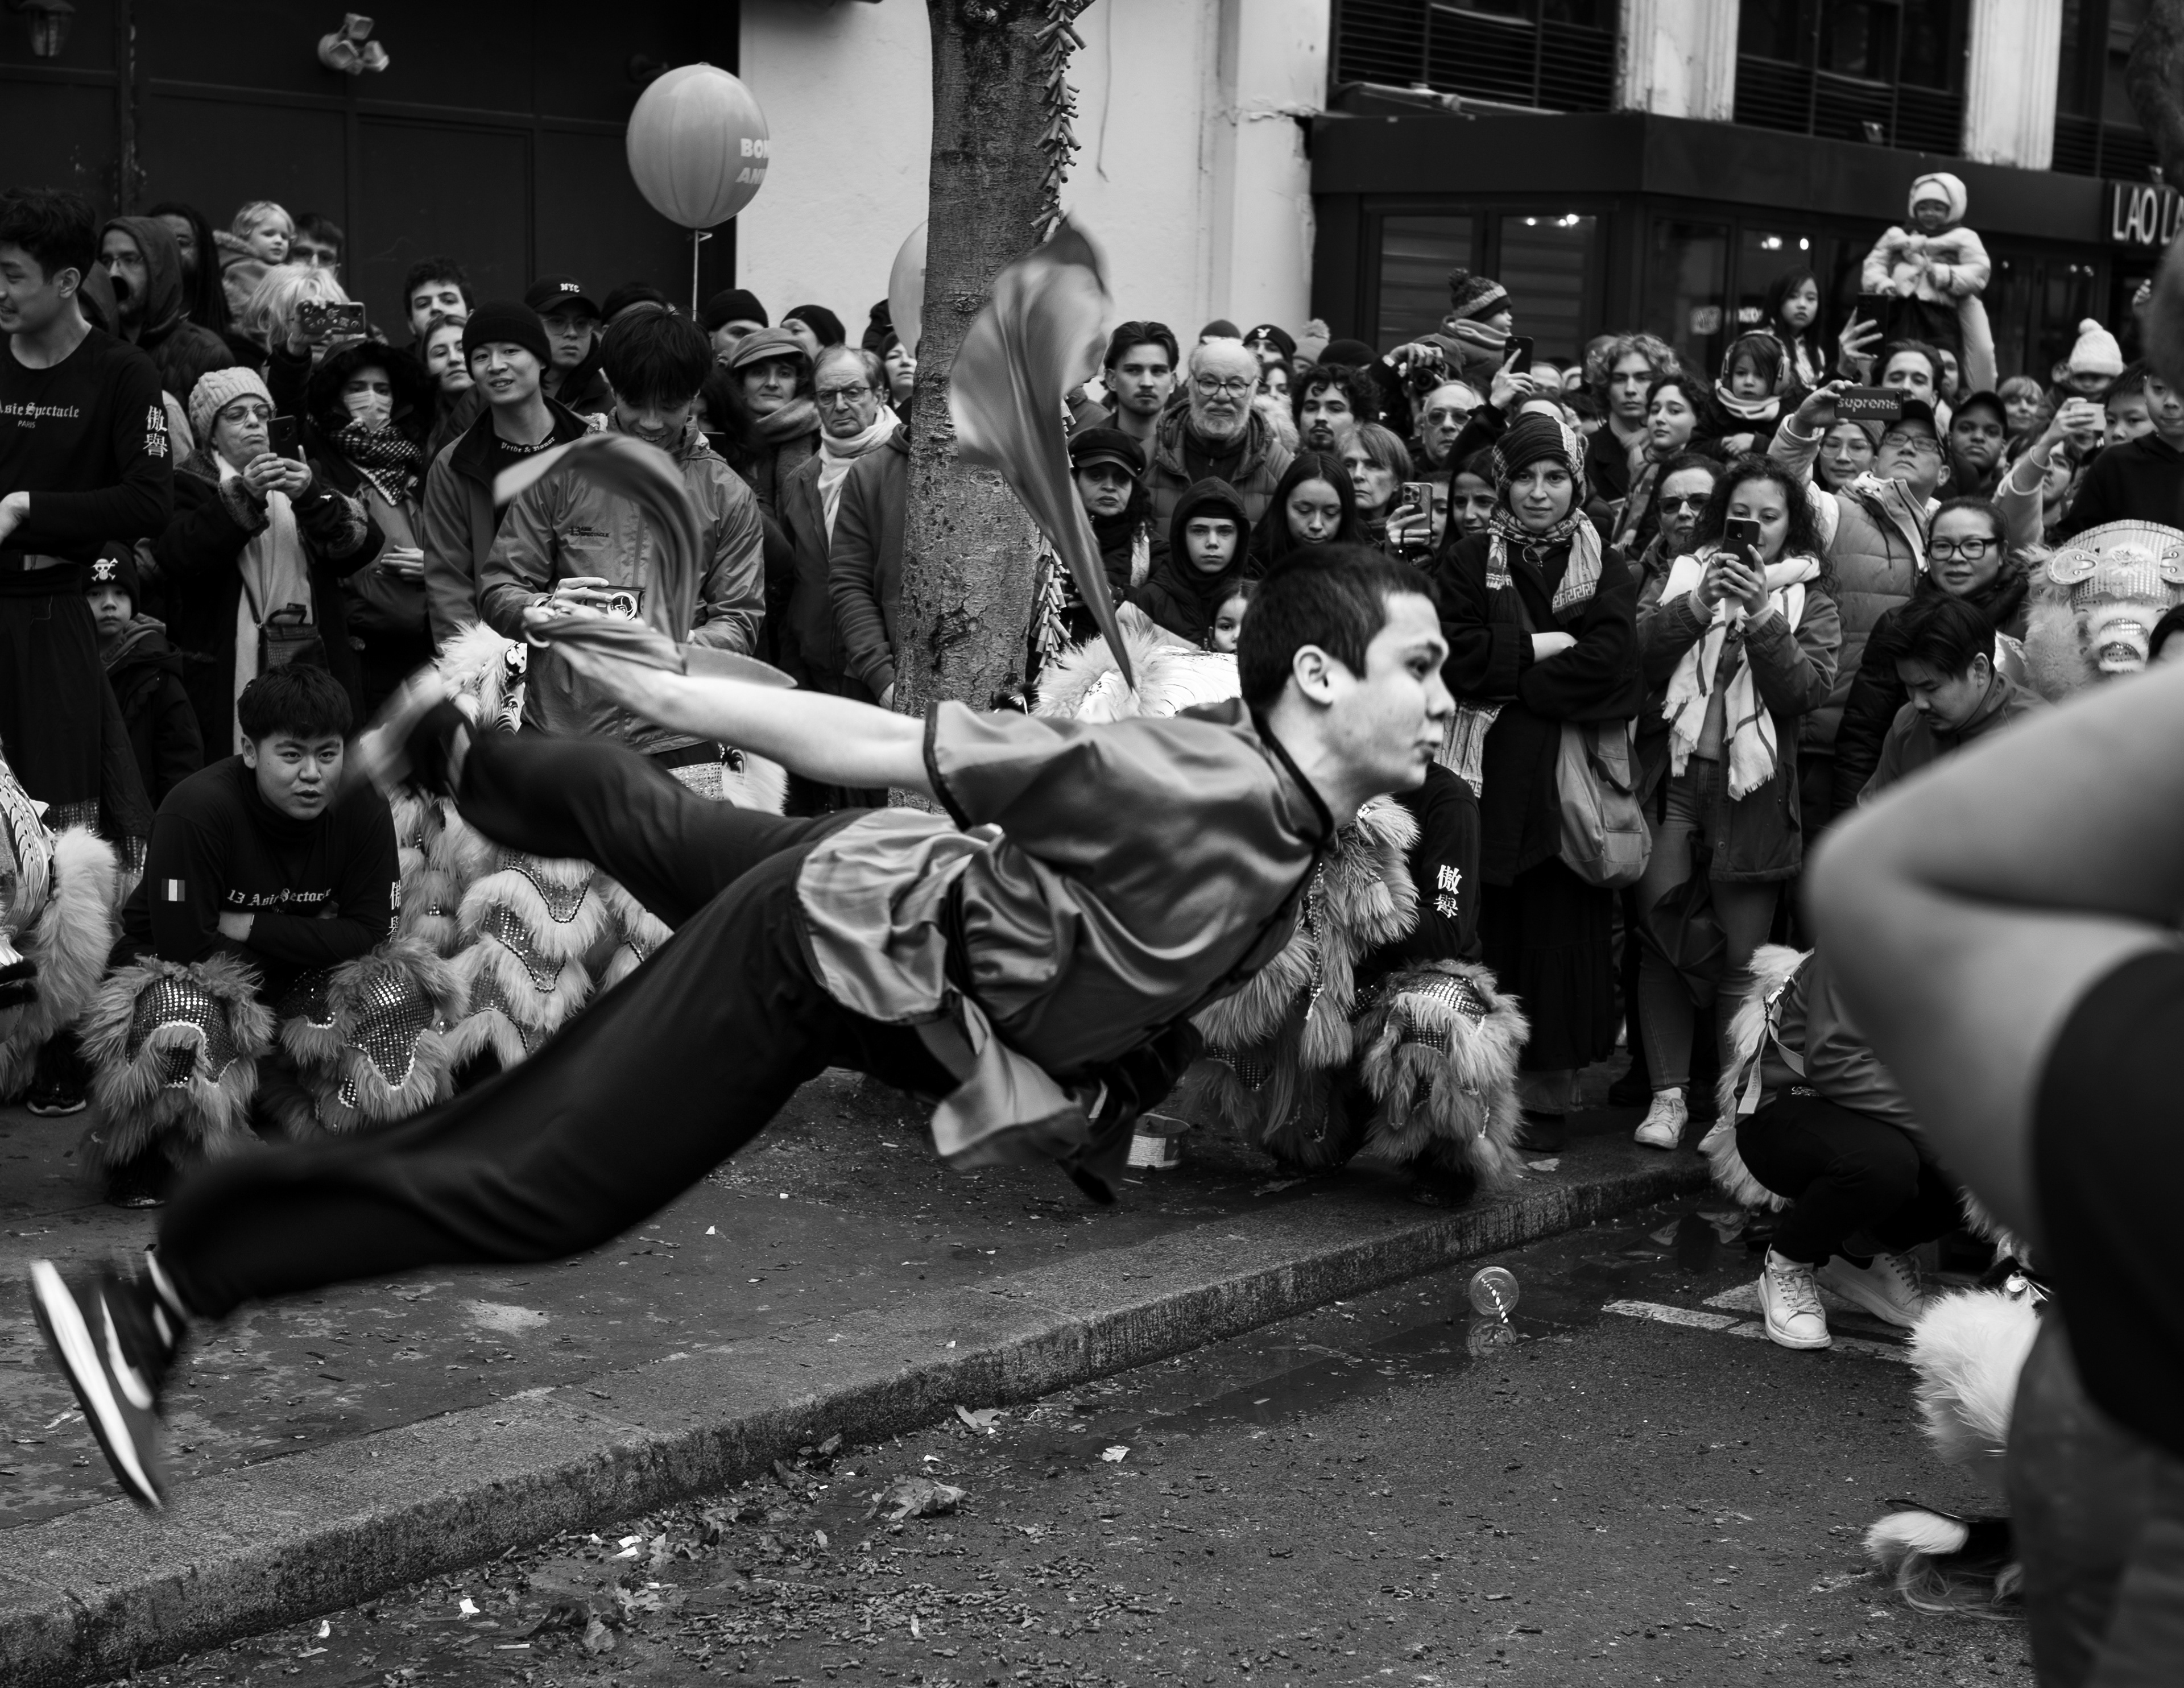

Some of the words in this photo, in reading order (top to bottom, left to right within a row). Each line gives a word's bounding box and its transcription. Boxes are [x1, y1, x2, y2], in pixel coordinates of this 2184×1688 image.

[2113, 183, 2158, 245] LAO
[25, 402, 80, 419] Spectacle
[1837, 398, 1899, 412] supreme
[18, 420, 36, 428] PARIS
[570, 526, 580, 536] 13
[228, 889, 245, 904] 13
